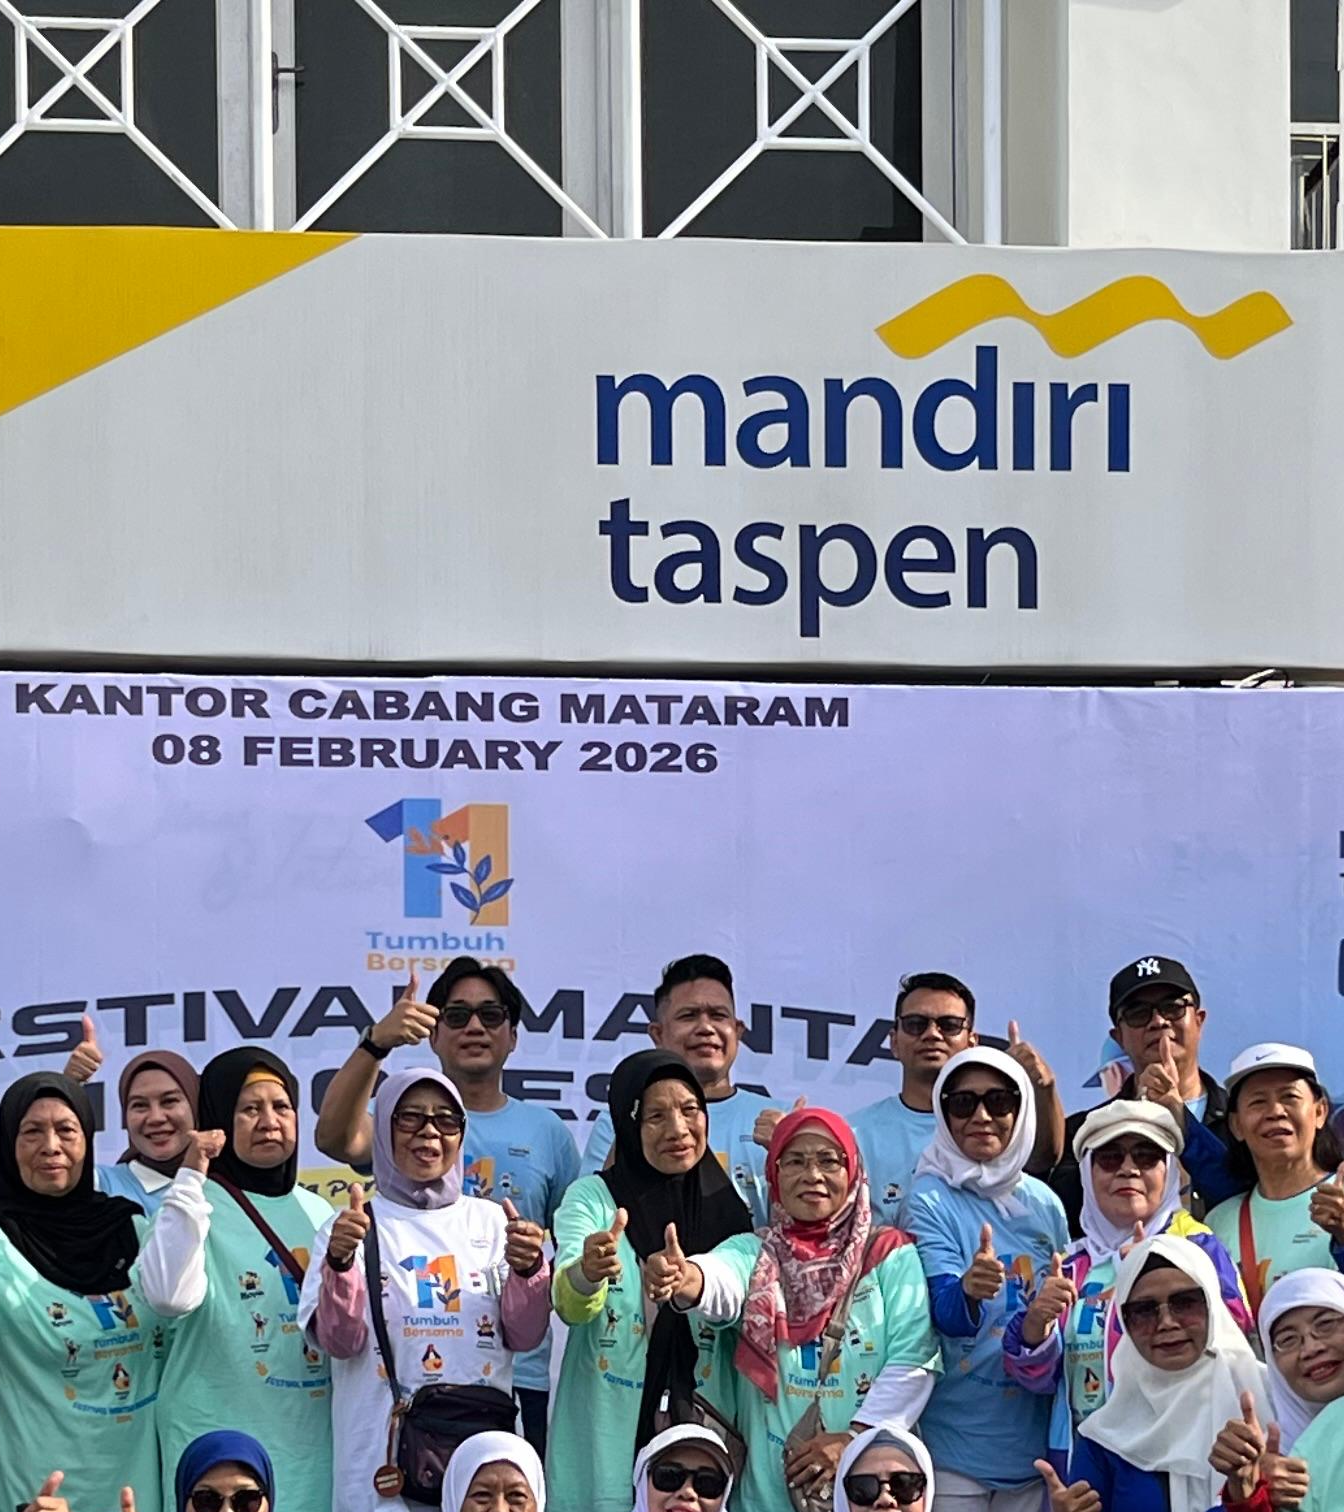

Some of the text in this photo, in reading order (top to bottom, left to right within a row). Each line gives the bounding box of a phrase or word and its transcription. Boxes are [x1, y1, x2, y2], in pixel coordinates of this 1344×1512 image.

[595, 345, 1131, 473] mandiri
[598, 497, 1039, 638] taspen
[14, 683, 850, 728] KANTOR CABANG MATARAM
[151, 733, 719, 774] 08 FEBRUARY 2026
[364, 931, 506, 952] Tumbuh
[366, 953, 517, 973] Bersa
[402, 1314, 460, 1326] Tumbuh
[402, 1326, 465, 1338] Bersama
[787, 1372, 840, 1387] Tumuh
